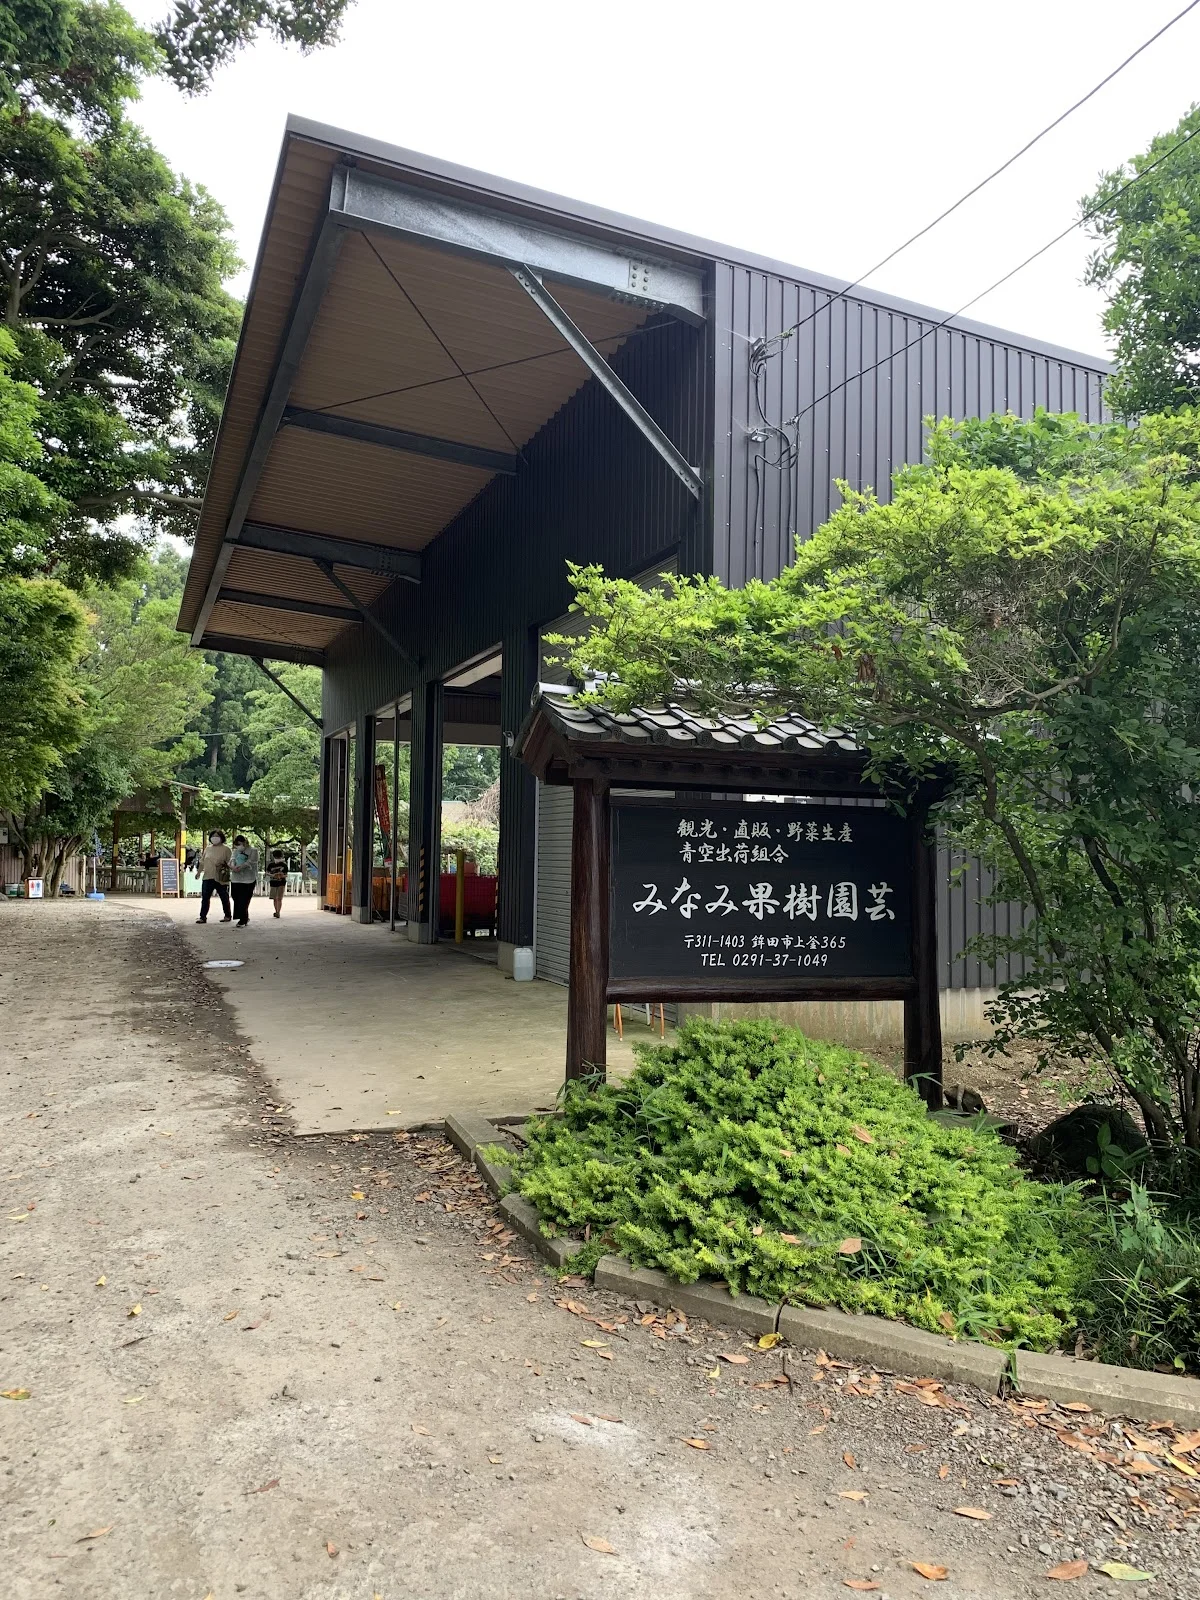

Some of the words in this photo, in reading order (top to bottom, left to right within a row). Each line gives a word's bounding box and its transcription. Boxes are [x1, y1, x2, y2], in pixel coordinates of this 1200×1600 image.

[678, 842, 789, 864] 青空出荷組合
[632, 877, 896, 922] みなみ果樹園芸
[751, 934, 847, 949] 鉾田市上釜365
[700, 953, 726, 967] TEL
[732, 953, 829, 967] 0291-37-1049
